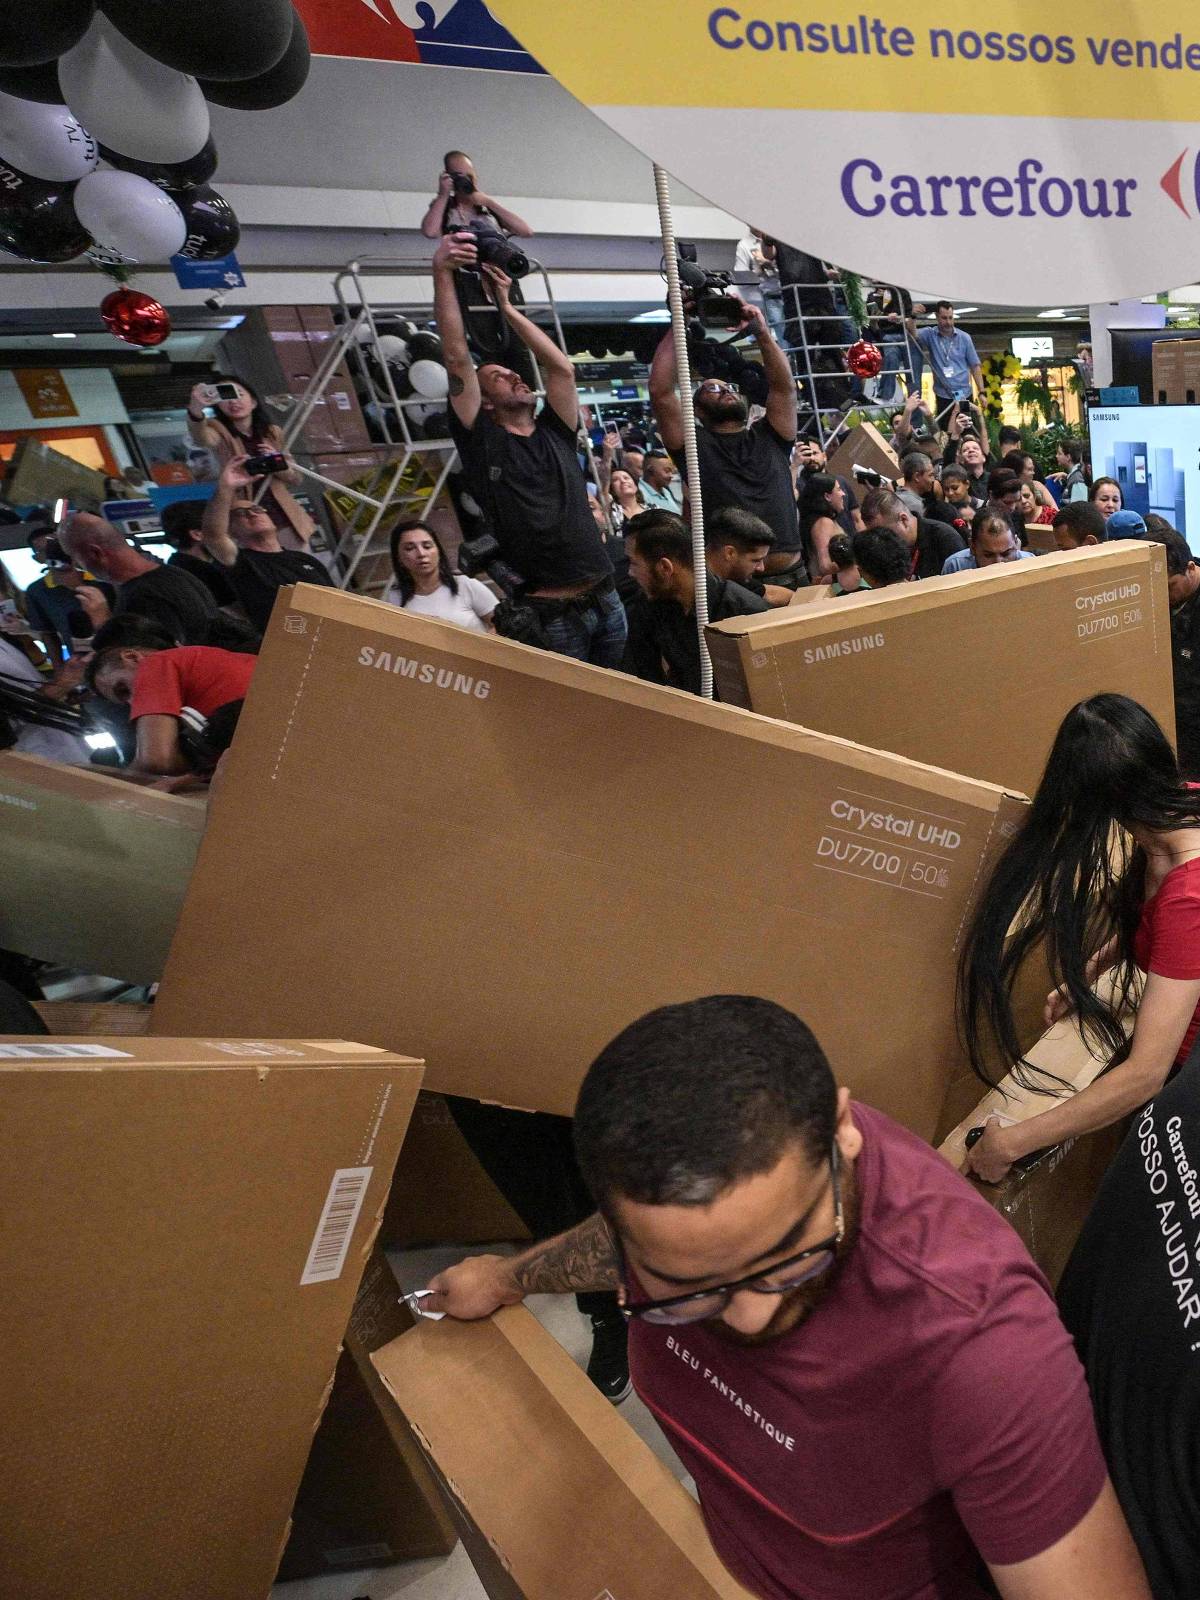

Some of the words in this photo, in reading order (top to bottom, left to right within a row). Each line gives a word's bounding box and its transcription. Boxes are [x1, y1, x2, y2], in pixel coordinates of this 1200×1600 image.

[707, 7, 915, 56] Consulte
[929, 30, 1076, 65] nossos
[840, 158, 1137, 219] Carrefour
[1092, 413, 1120, 421] SAMSUNG
[1075, 588, 1118, 610] Crystal
[1119, 583, 1141, 599] UHD
[803, 633, 885, 664] SAMSUNG
[1077, 615, 1119, 638] DU7700
[358, 646, 490, 698] SAMSUNG
[830, 800, 914, 837] Crystal
[917, 822, 961, 849] UHD
[816, 836, 901, 874] DU7700
[1138, 1103, 1168, 1194] POSSO
[666, 1336, 701, 1373] BLEU
[703, 1367, 795, 1451] FANTASTIQUE
